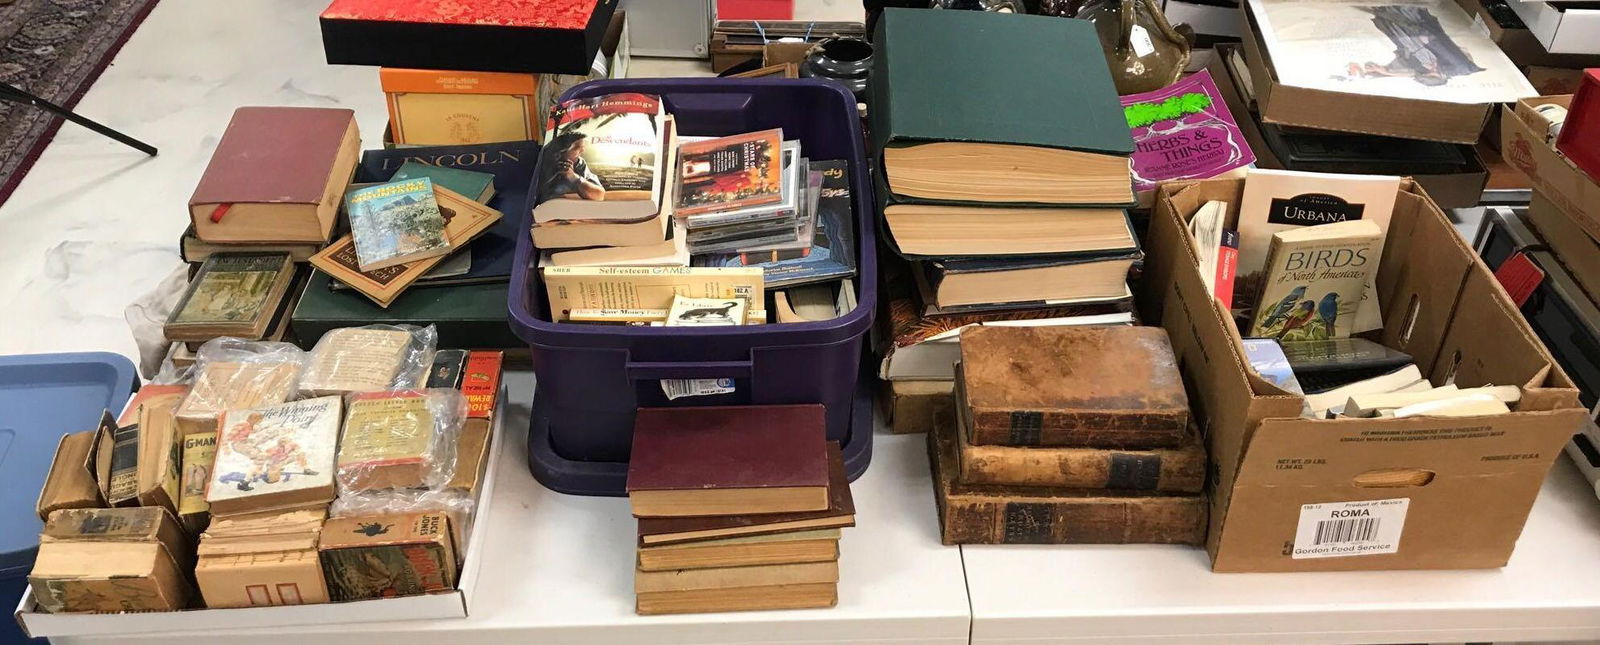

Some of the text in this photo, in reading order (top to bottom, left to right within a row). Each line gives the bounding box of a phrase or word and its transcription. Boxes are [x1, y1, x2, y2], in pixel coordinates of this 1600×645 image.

[578, 103, 599, 111] Hart
[602, 99, 653, 109] Hemmings
[1136, 129, 1208, 153] HERBS &
[1161, 137, 1223, 162] THINGS
[823, 168, 843, 179] dy
[1284, 206, 1347, 222] URBANA
[1285, 247, 1370, 271] BIRDS
[1287, 270, 1317, 283] North
[1319, 269, 1361, 280] America
[277, 403, 329, 419] Winning
[1331, 509, 1370, 518] ROMA
[420, 514, 431, 536] JONES
[429, 515, 440, 535] BUCK
[1295, 547, 1329, 555] Gordon
